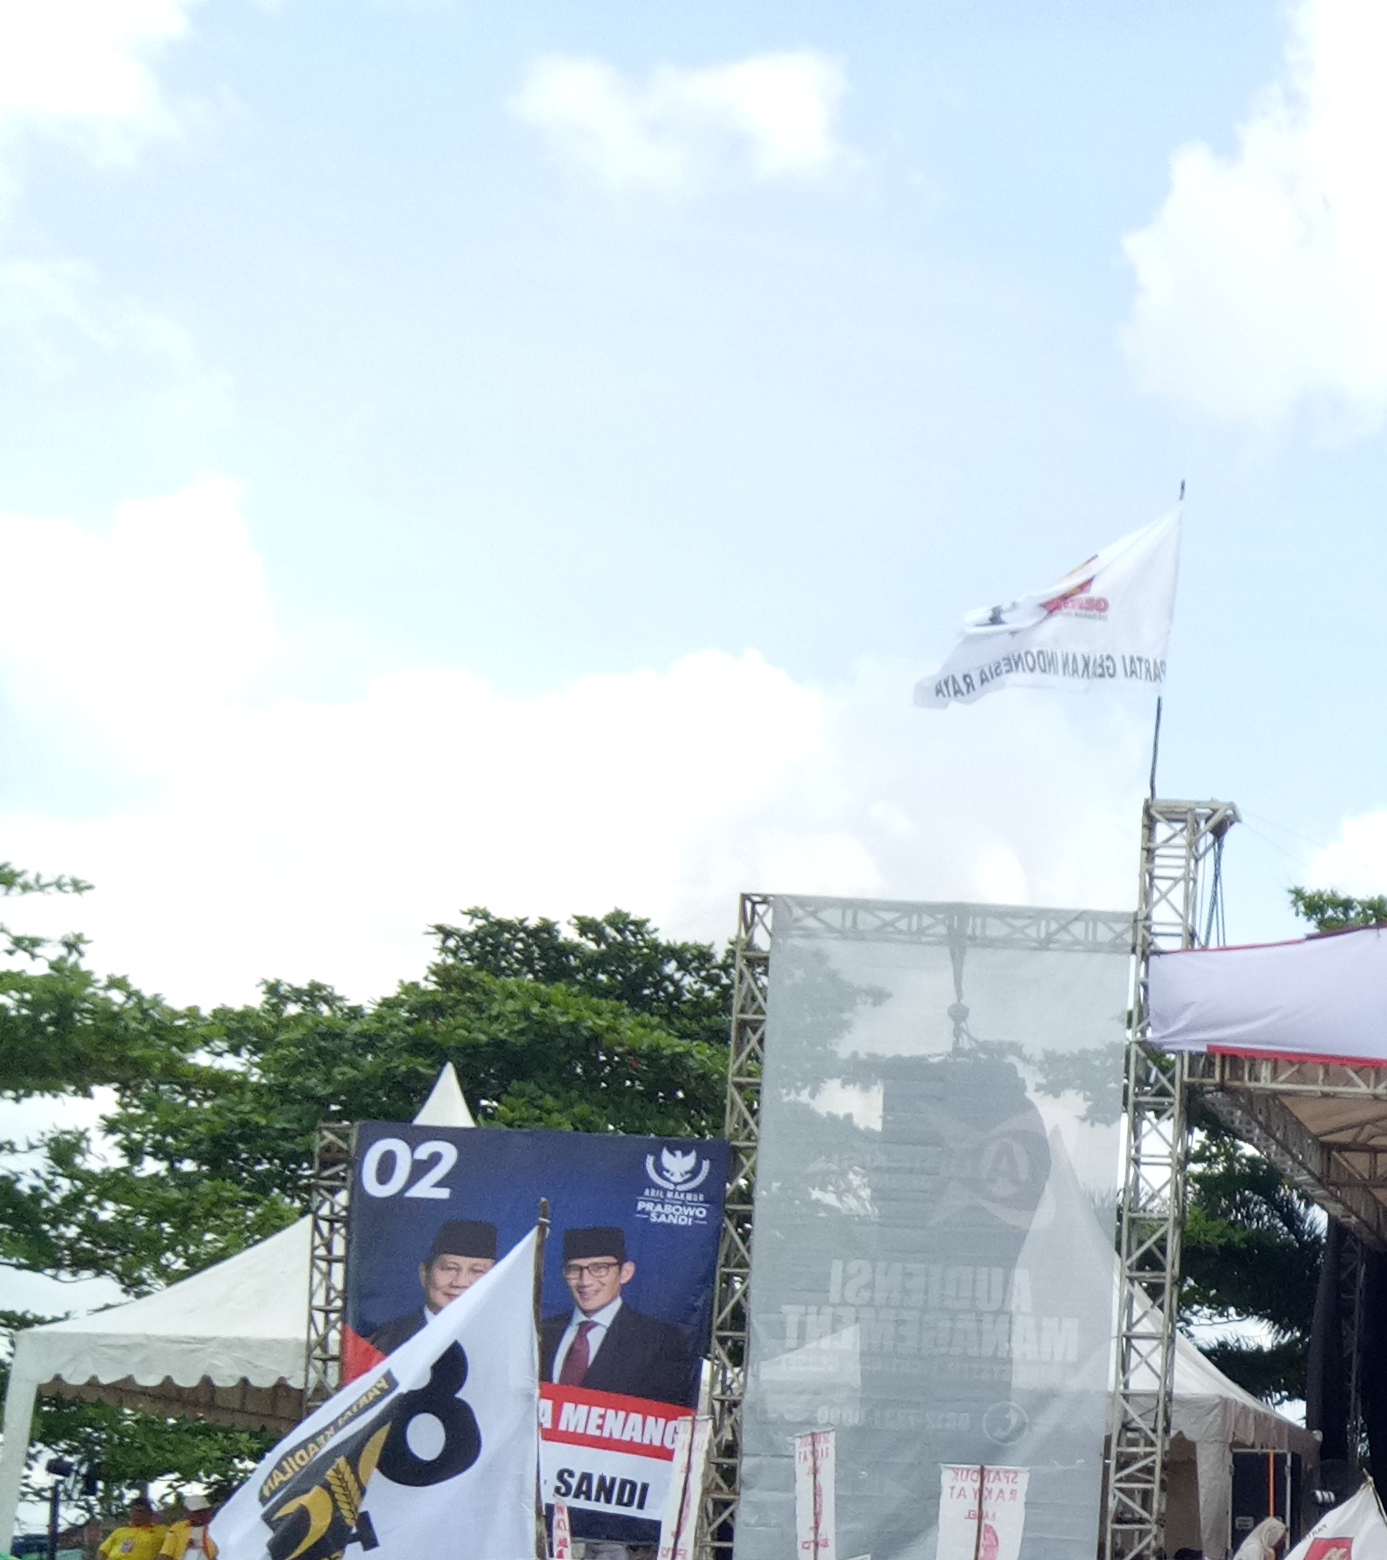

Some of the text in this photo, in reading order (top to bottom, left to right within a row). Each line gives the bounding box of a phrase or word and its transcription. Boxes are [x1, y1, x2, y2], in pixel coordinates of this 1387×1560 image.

[361, 1138, 458, 1199] 02
[636, 1201, 707, 1218] PRABOWO
[649, 1212, 693, 1225] SANDI
[559, 1402, 681, 1450] MENANG
[554, 1468, 650, 1510] SANDI
